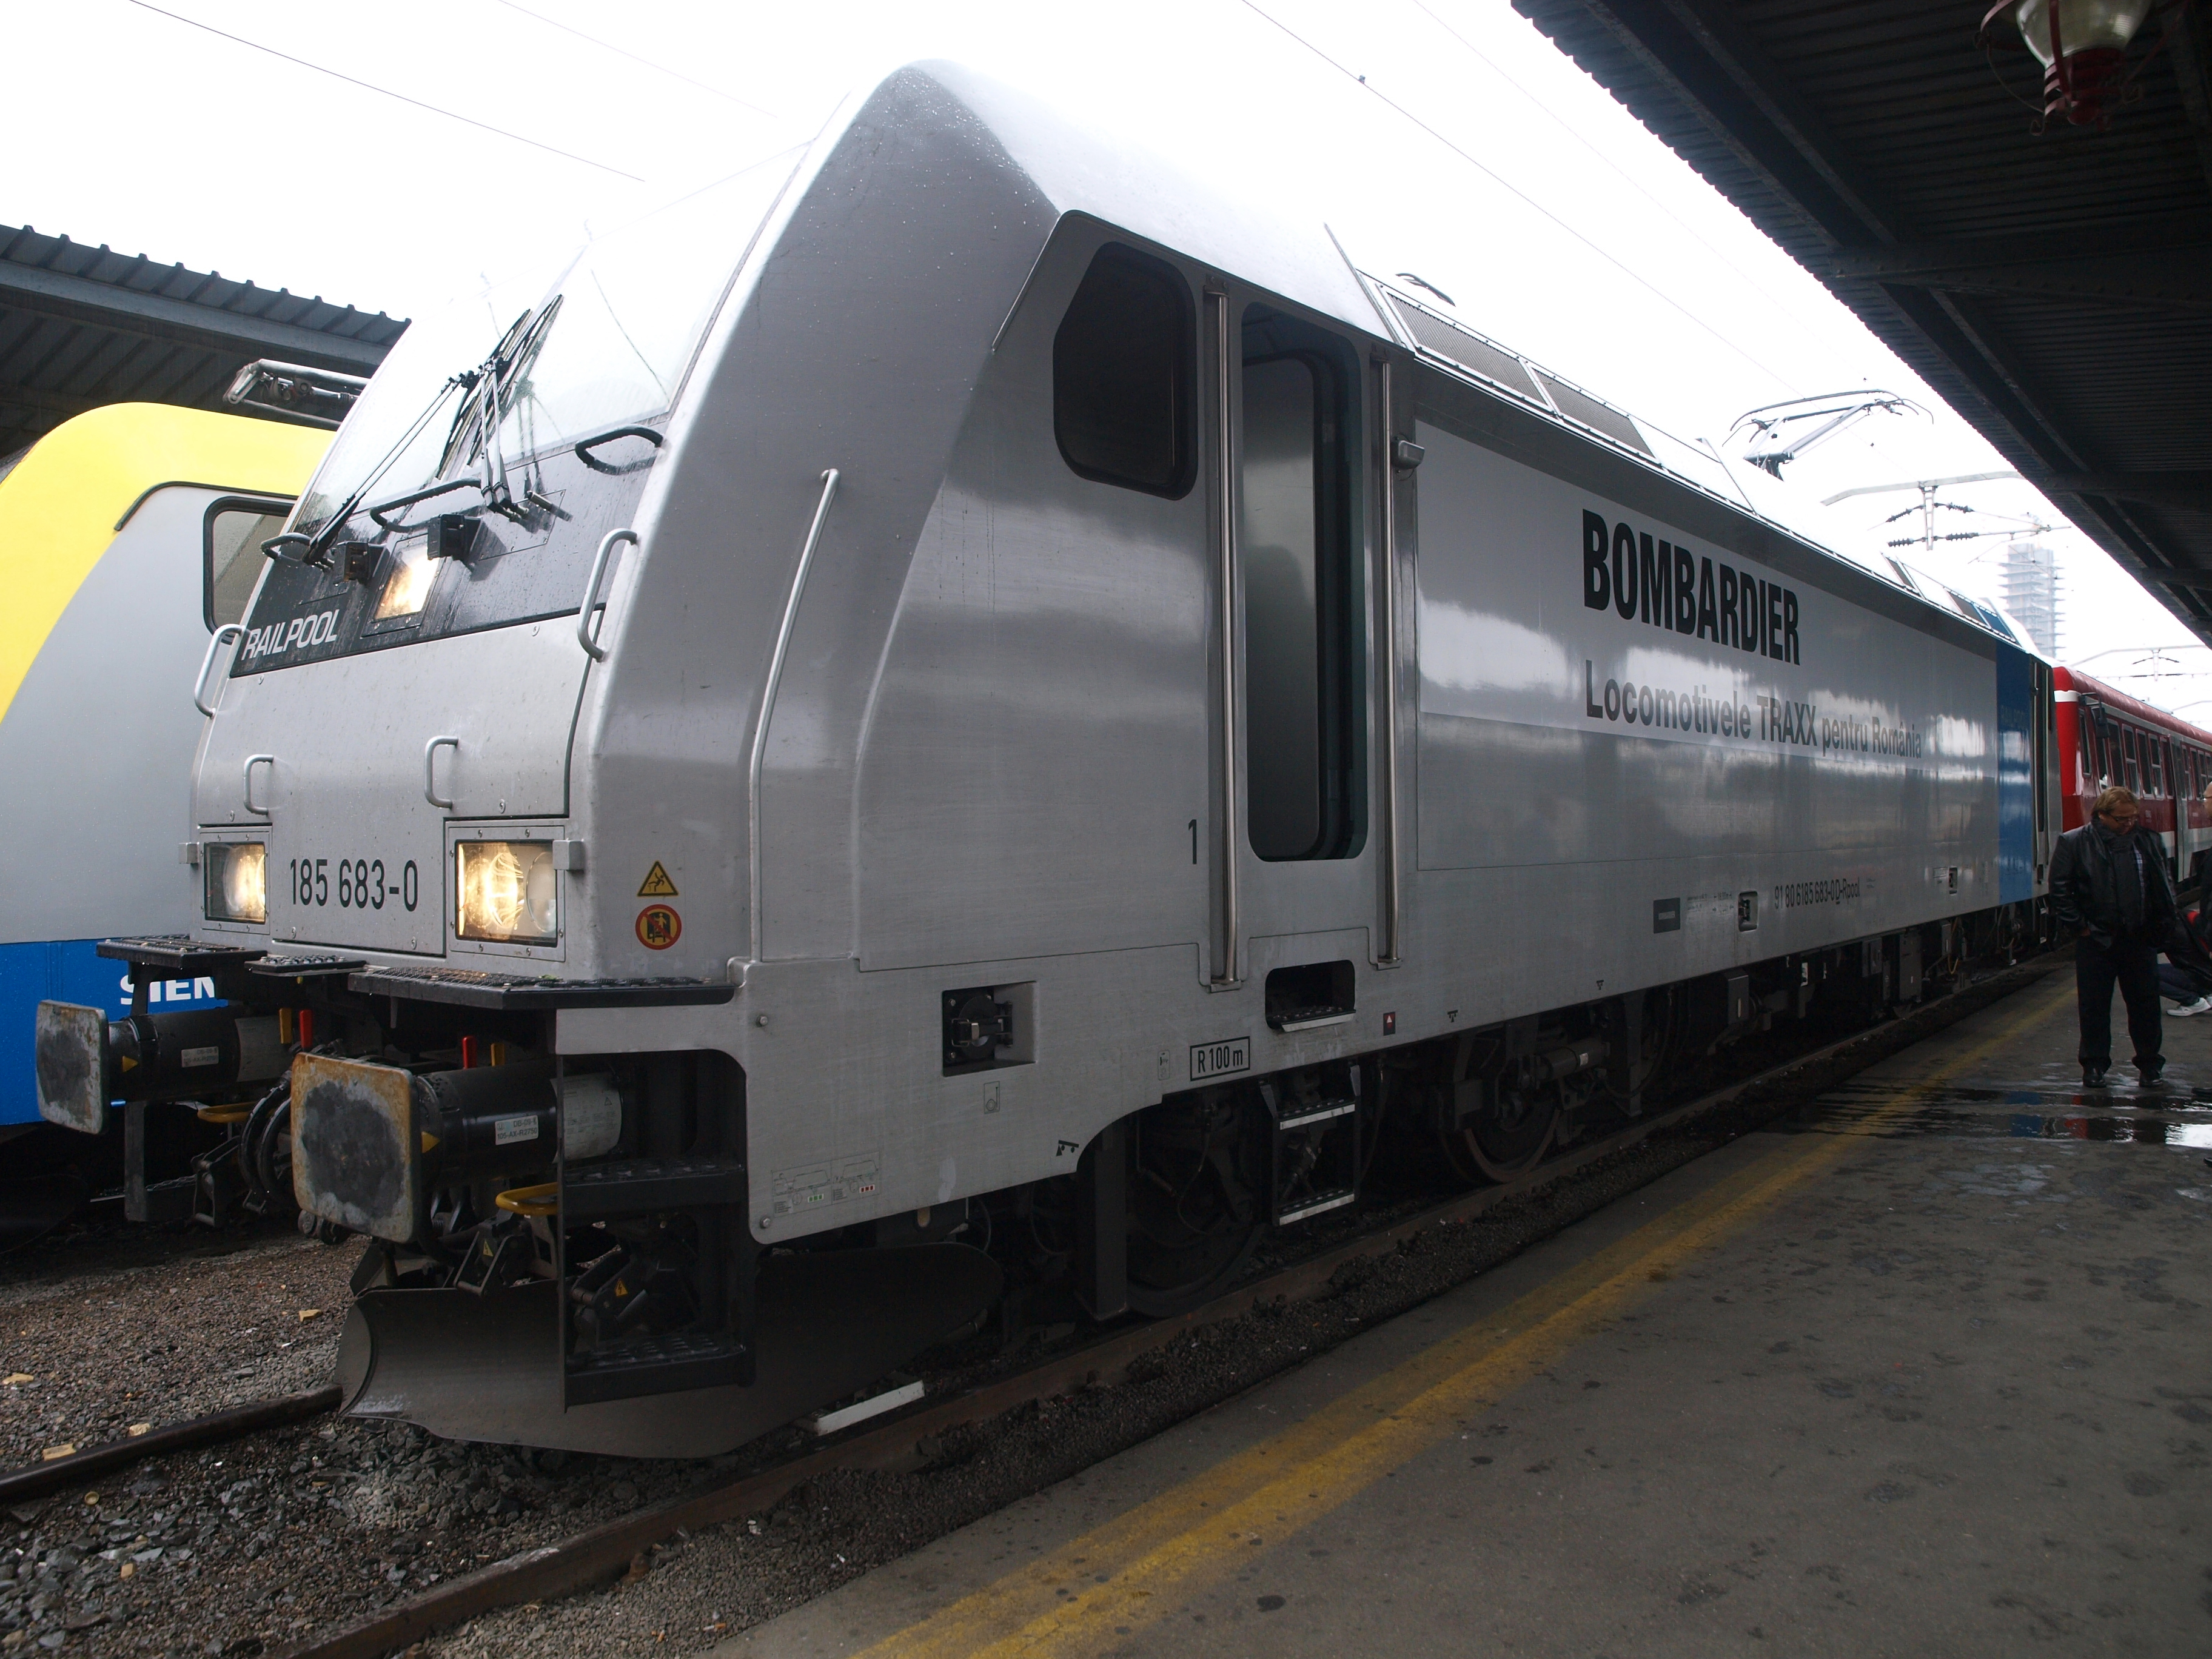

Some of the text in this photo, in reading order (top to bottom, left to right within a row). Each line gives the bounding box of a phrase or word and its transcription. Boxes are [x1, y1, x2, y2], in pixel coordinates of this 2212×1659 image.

[1583, 509, 1800, 666] BOMBARDIER
[241, 609, 340, 660] RAILPOOL
[1586, 660, 1922, 759] Locomotivele TRAXX pentru România
[1188, 819, 1197, 865] 1
[290, 859, 418, 911] 185 683-0
[1774, 885, 1783, 909] 91
[1785, 884, 1795, 908] 80
[1796, 881, 1814, 905] 6185
[1198, 1045, 1243, 1073] R 100 m
